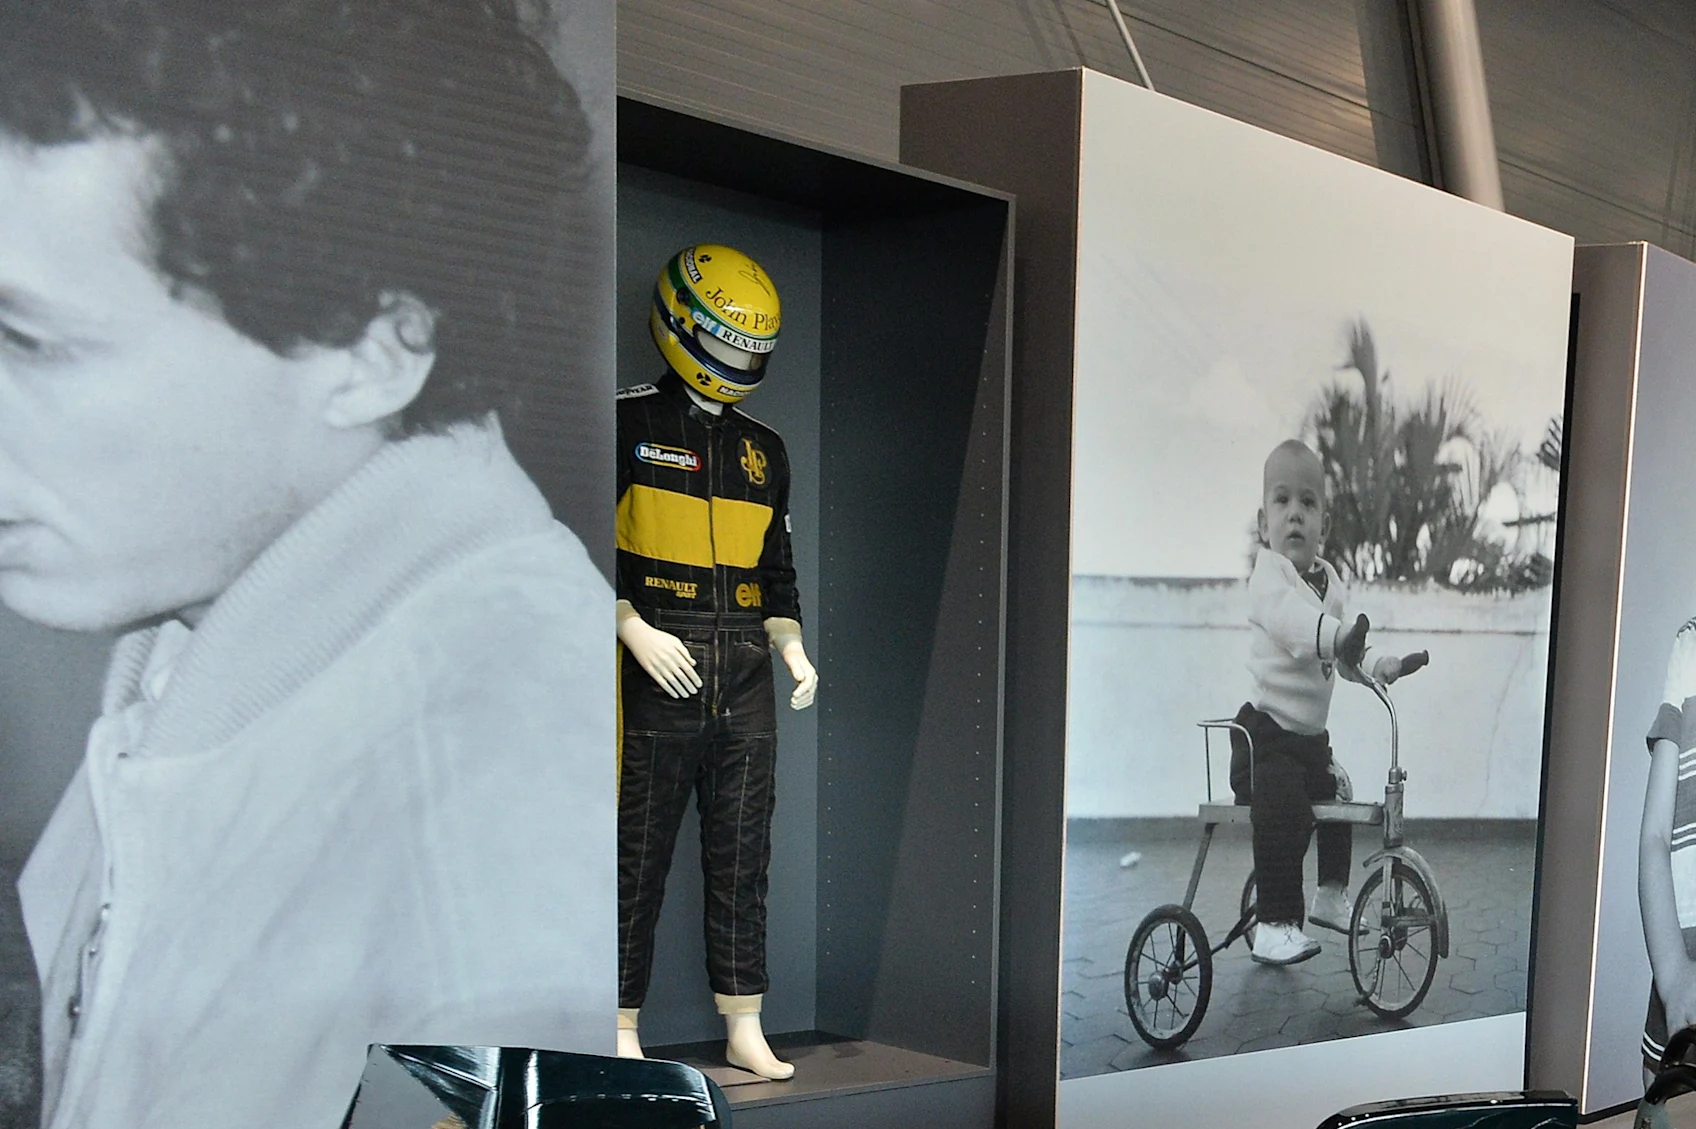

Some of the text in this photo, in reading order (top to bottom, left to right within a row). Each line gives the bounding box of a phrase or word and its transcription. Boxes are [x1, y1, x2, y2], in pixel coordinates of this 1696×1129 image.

[706, 286, 747, 325] John
[692, 311, 776, 351] elf RENAULT
[639, 446, 698, 468] DeLonghi
[645, 576, 698, 592] RENAULT
